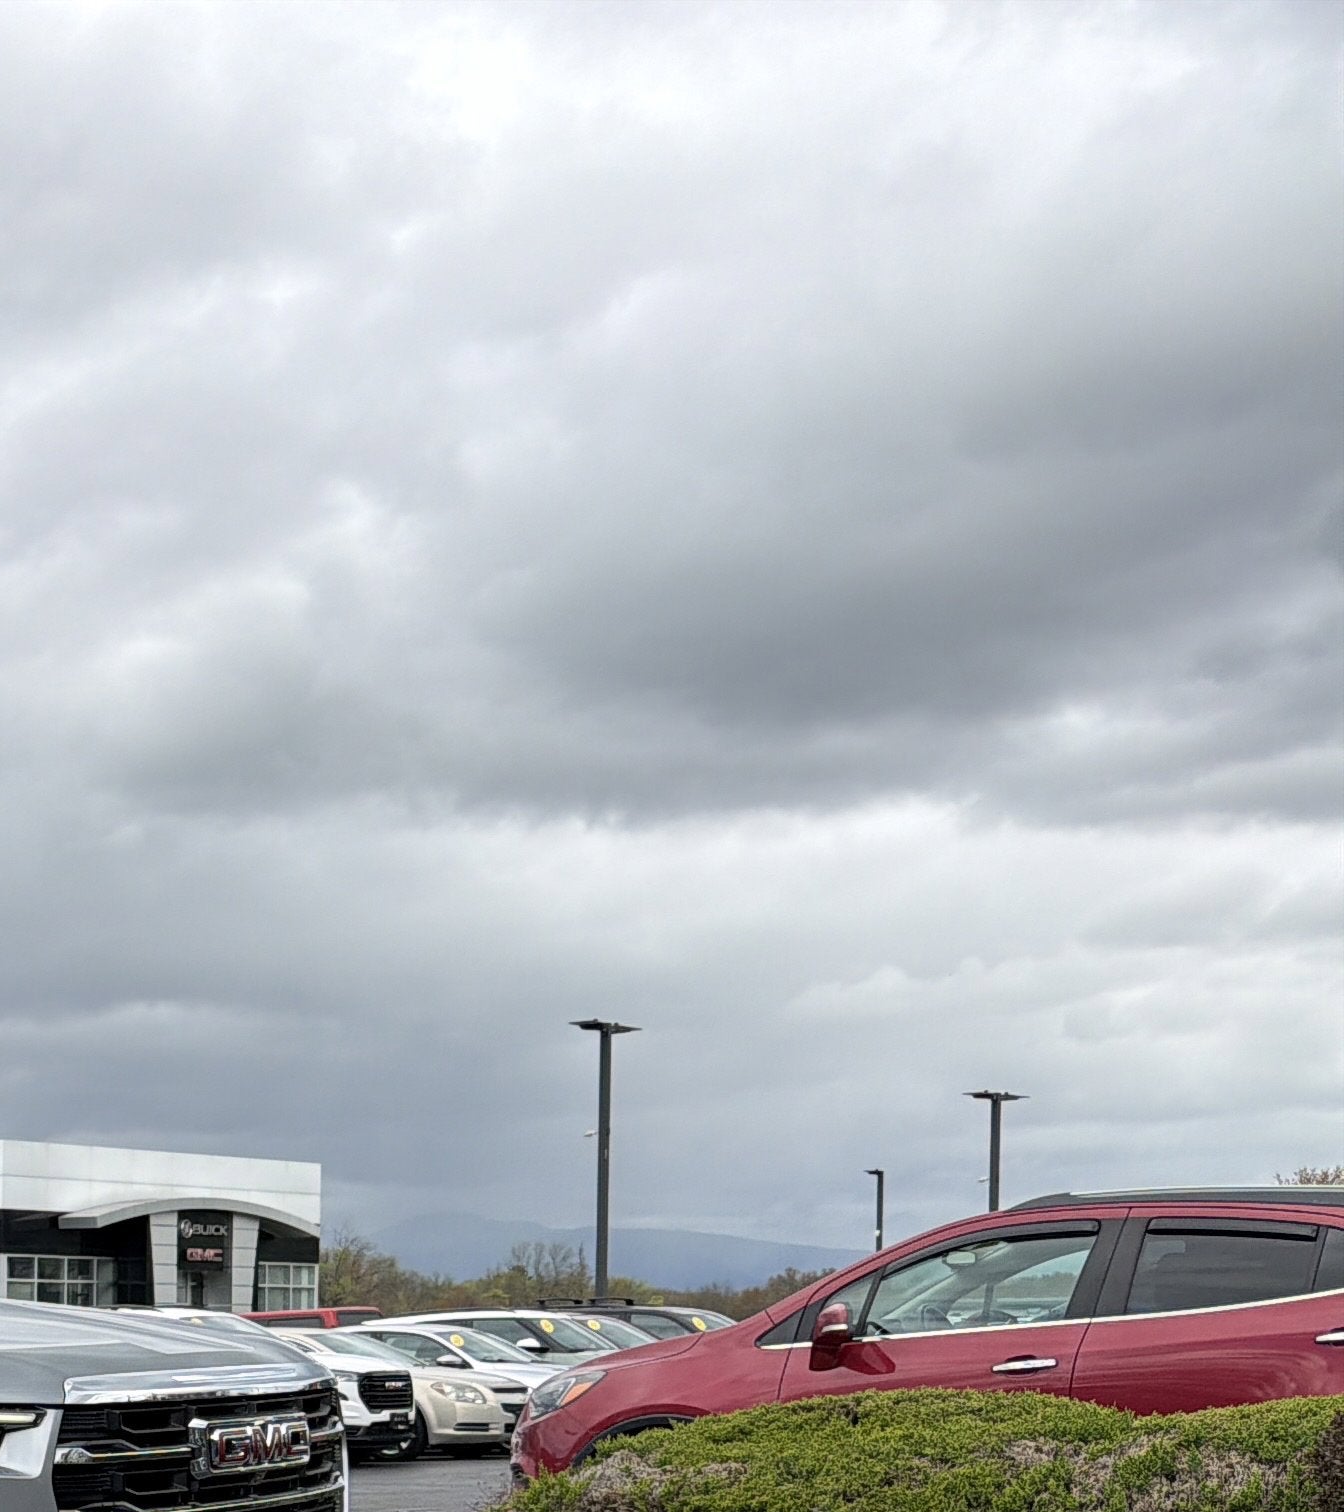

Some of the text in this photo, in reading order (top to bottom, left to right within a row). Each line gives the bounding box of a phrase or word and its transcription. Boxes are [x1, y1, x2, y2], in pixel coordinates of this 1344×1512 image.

[192, 1223, 228, 1237] BUICK
[187, 1247, 223, 1262] GMC
[212, 1421, 310, 1467] GMC
